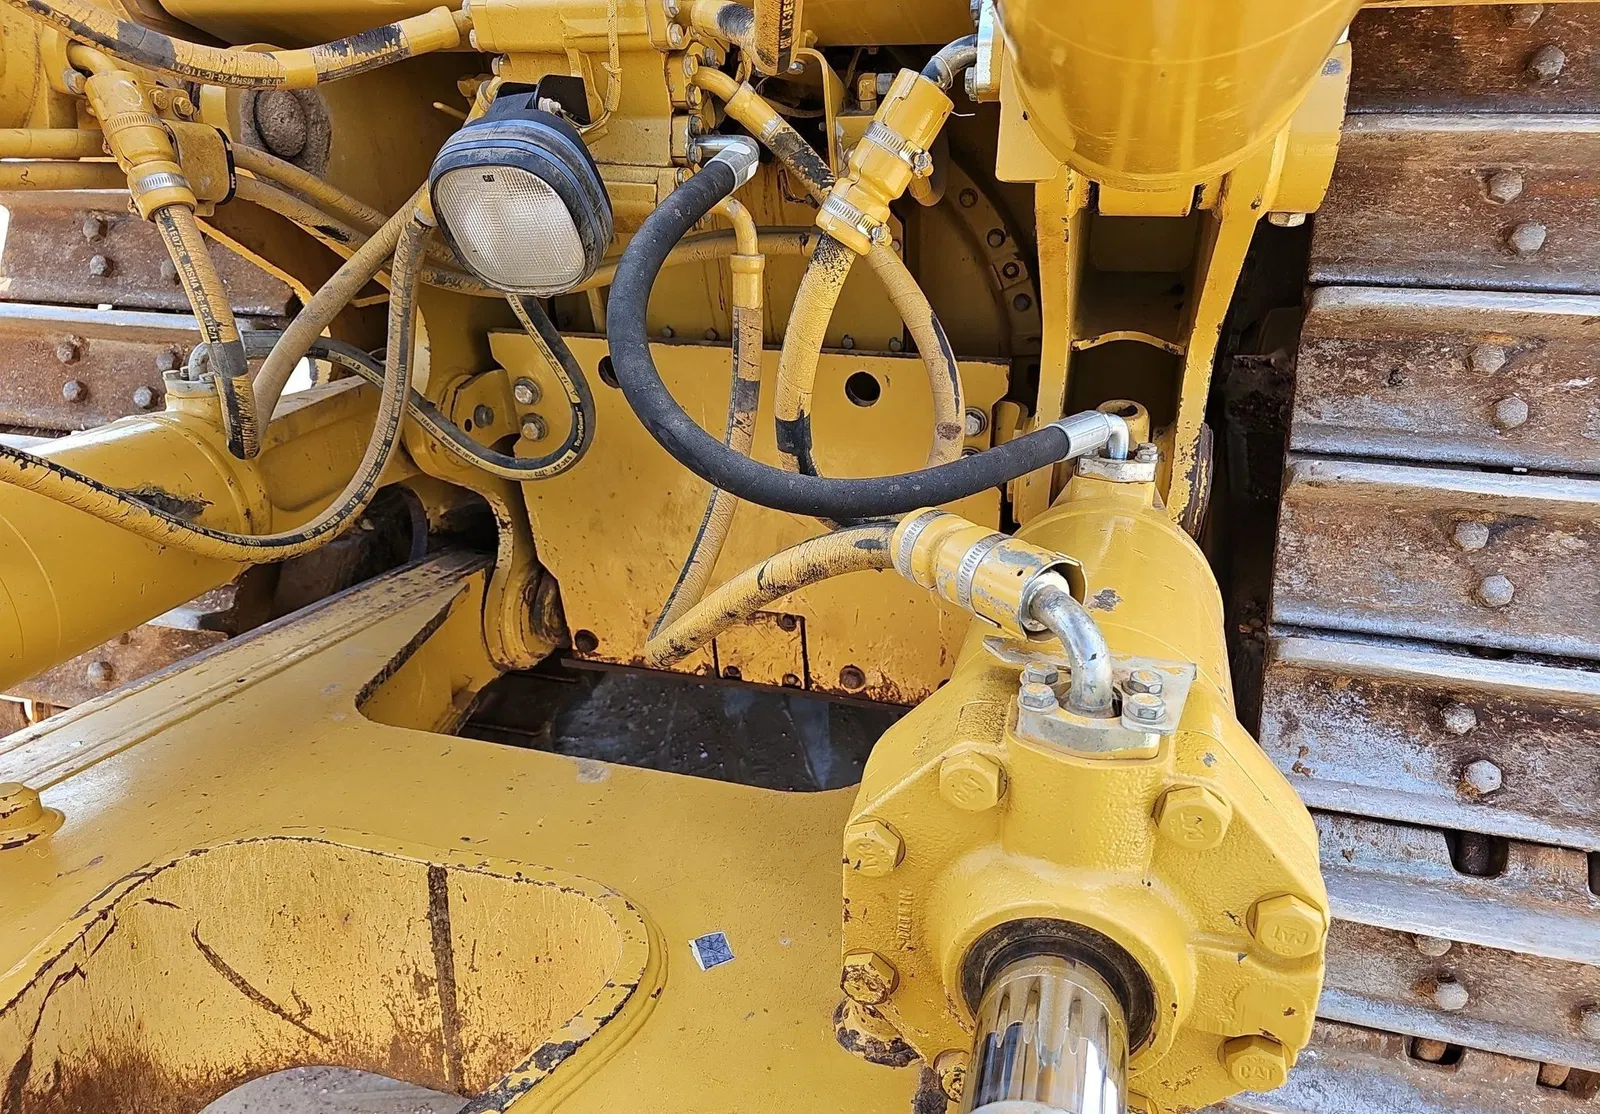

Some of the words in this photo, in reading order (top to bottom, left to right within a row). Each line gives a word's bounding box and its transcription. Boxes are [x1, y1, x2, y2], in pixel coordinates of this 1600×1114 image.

[482, 174, 496, 183] CAT
[167, 225, 187, 258] 1E0736
[182, 262, 200, 290] MSHA
[1237, 1063, 1274, 1081] CAT
